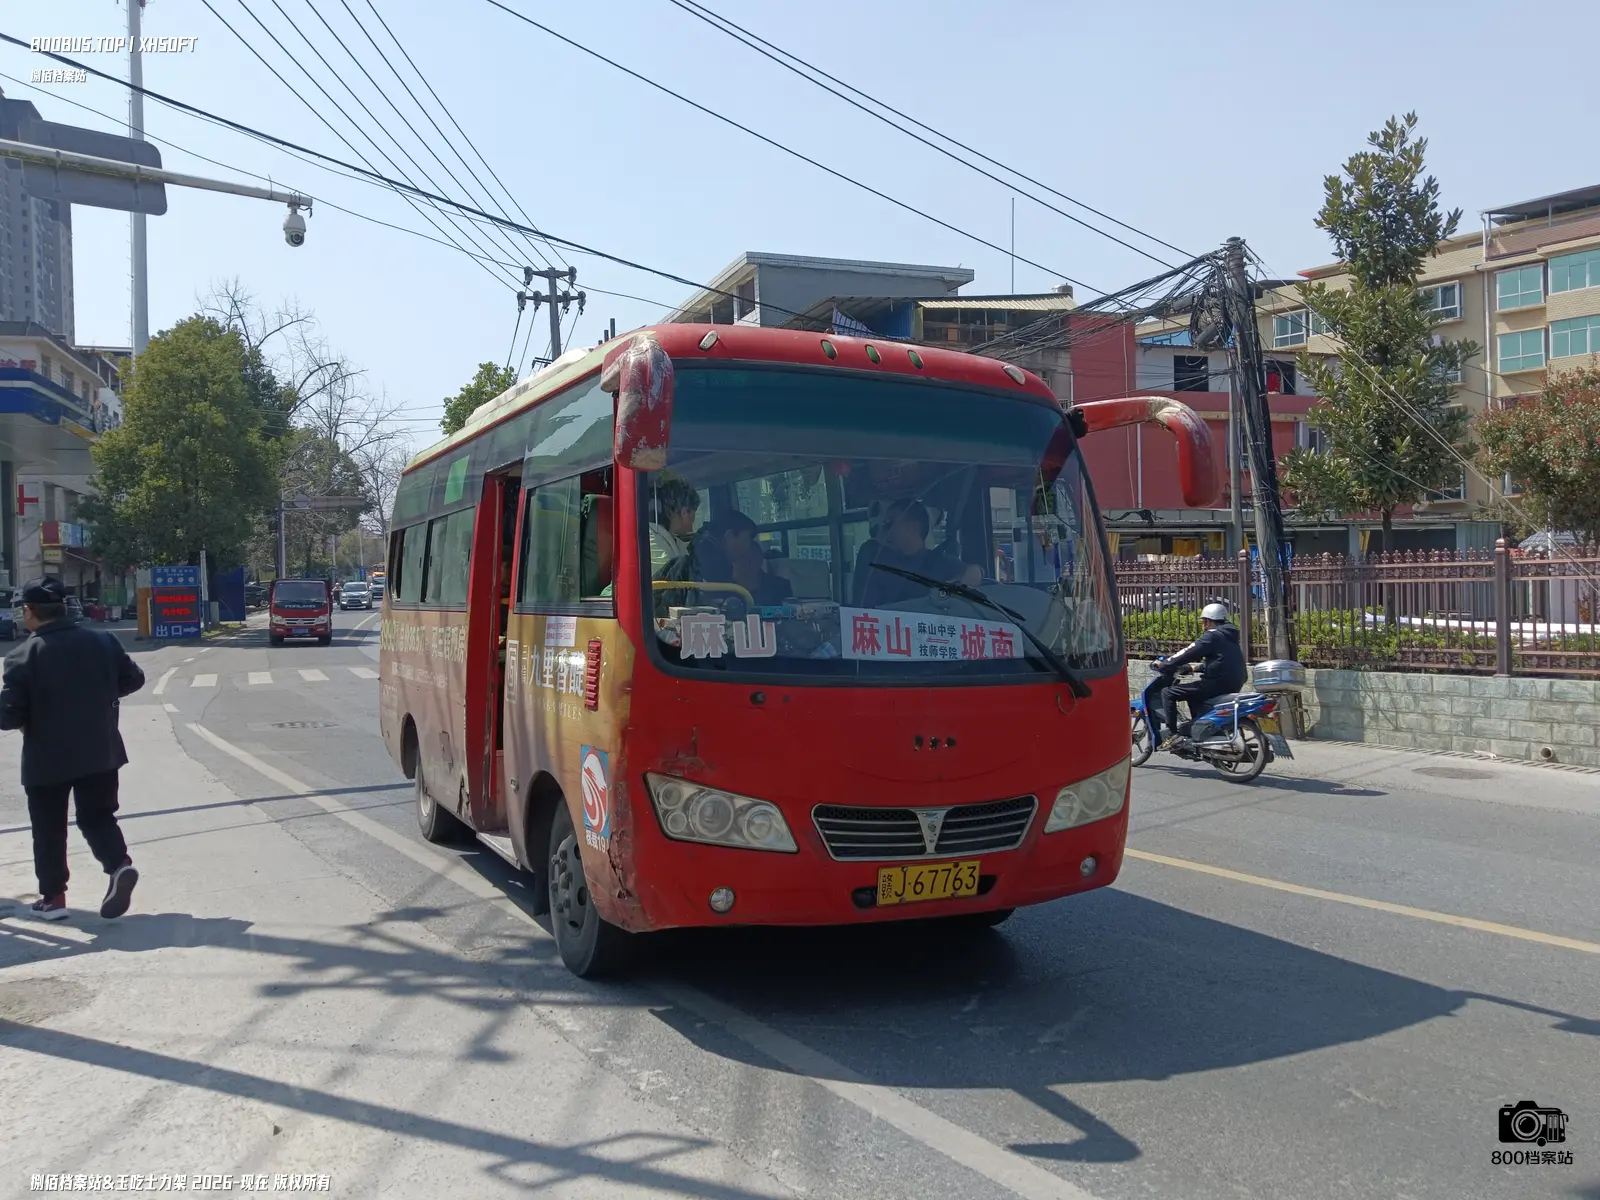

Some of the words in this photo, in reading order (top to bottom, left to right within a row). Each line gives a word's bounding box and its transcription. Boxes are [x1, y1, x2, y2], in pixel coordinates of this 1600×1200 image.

[156, 624, 183, 637] 出口
[680, 613, 777, 660] 麻山
[852, 612, 912, 657] 麻山
[917, 622, 957, 637] 麻山中学
[960, 624, 1014, 660] 城南
[919, 643, 958, 660] 技师学院
